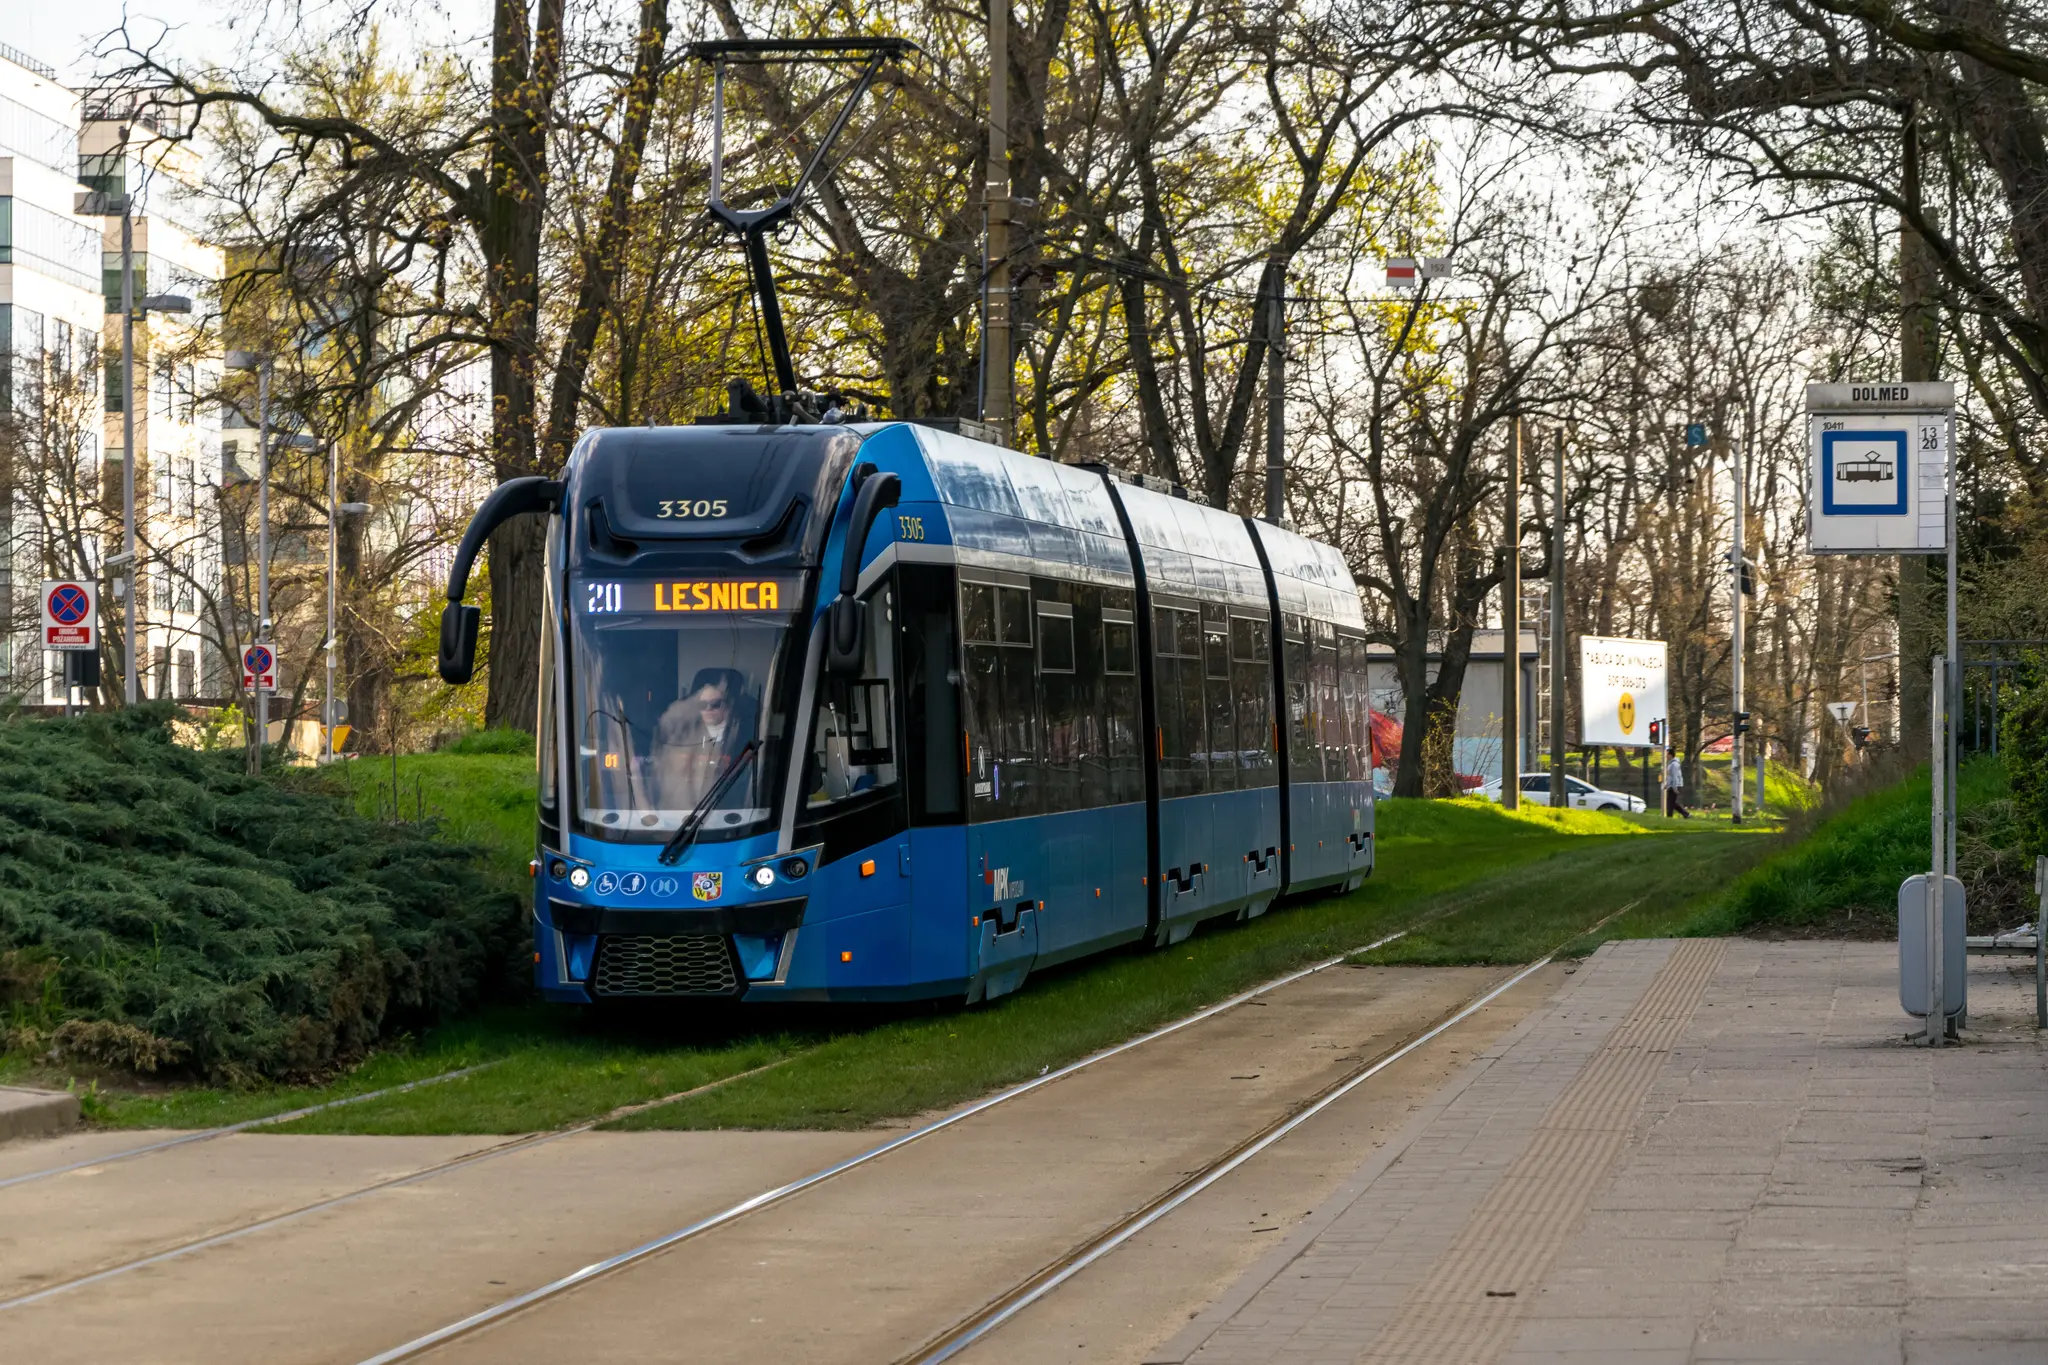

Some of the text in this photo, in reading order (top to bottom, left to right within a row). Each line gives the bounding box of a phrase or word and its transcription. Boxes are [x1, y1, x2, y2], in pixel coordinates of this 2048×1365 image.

[1852, 387, 1909, 401] DOLMED
[1822, 421, 1844, 430] 10411
[1921, 427, 1937, 439] 13
[1921, 438, 1938, 450] 20
[656, 499, 728, 518] 3305
[898, 515, 925, 540] 3305
[587, 581, 779, 613] 20 LEŚNICA
[604, 753, 618, 768] 01
[993, 867, 1010, 902] MPK
